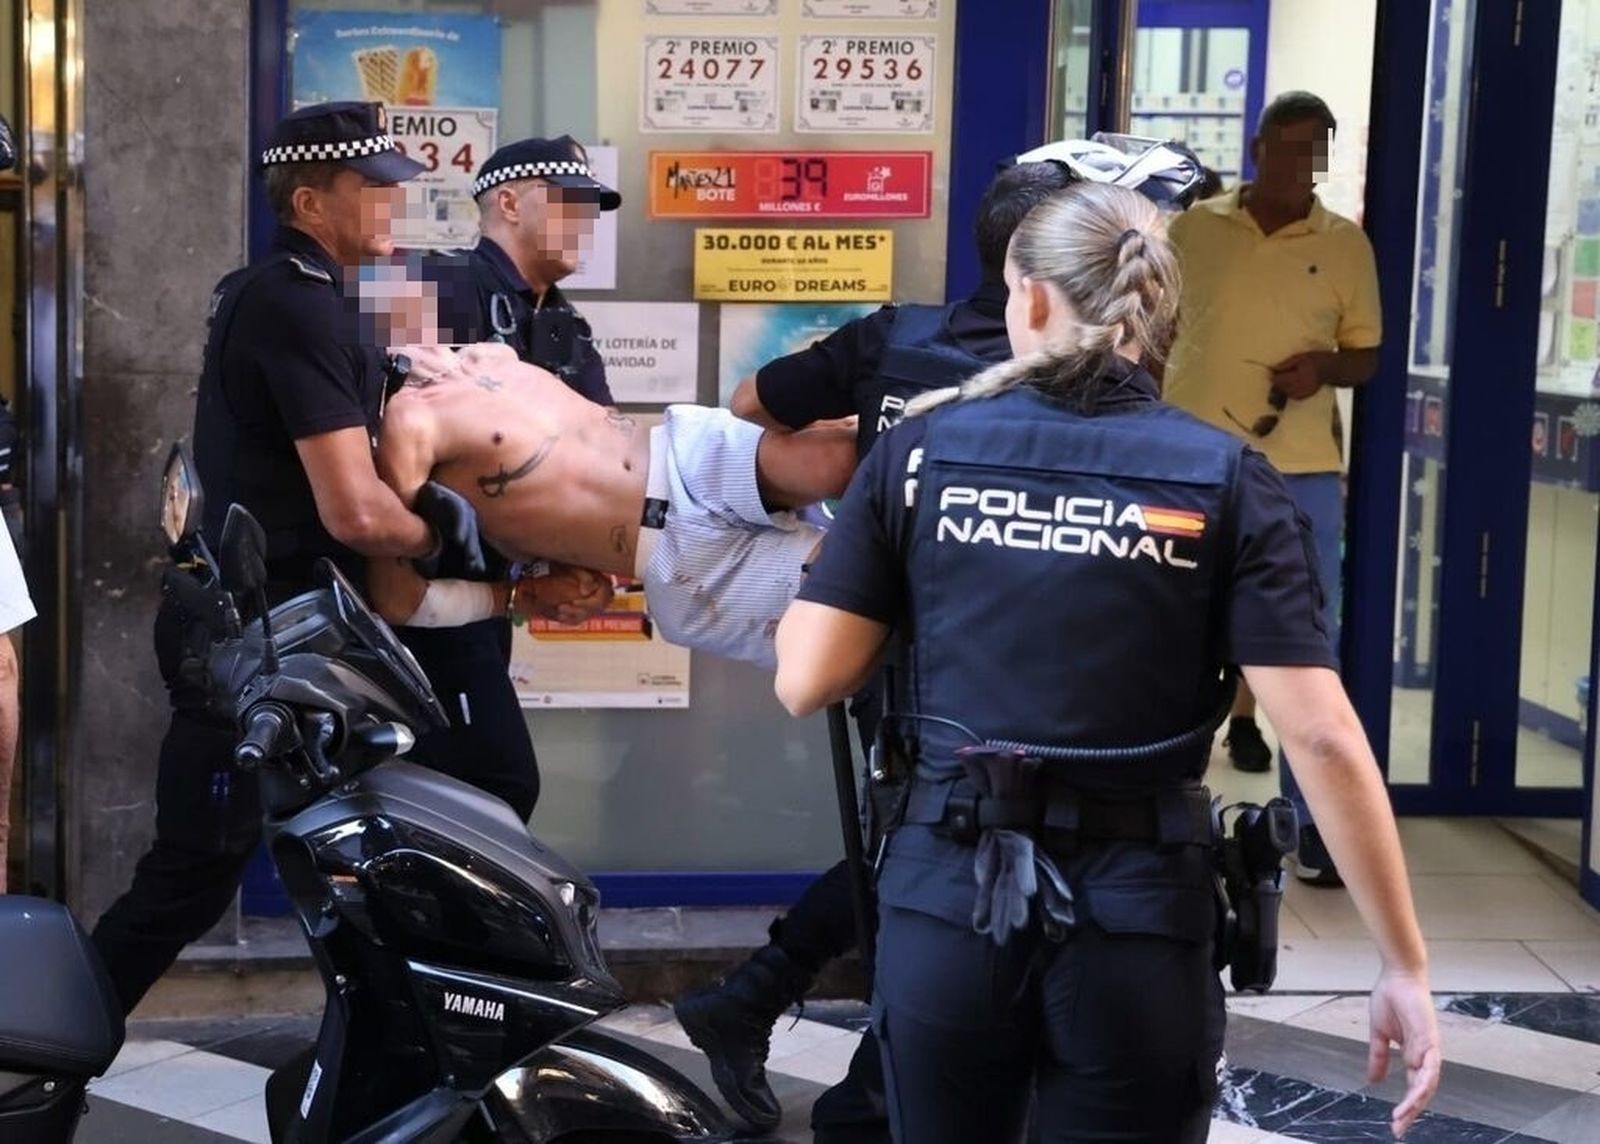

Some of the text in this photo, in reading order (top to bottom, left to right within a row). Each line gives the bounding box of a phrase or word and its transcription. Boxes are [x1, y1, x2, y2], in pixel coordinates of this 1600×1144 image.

[690, 41, 757, 56] PREMIO
[846, 40, 914, 55] PREMIO
[658, 58, 765, 79] 24077
[813, 58, 923, 80] 29536
[393, 116, 457, 137] EMIO
[782, 158, 827, 201] 39
[697, 188, 736, 201] BOTE
[758, 202, 812, 212] MILLONES
[703, 235, 781, 251] 30.000
[786, 235, 798, 250] €
[803, 235, 830, 250] AL
[728, 279, 777, 292] EURO
[795, 279, 867, 293] DREAMS
[605, 336, 658, 350] LOTERÍA
[661, 339, 677, 350] DE
[937, 516, 1198, 569] NACIONAL
[444, 992, 505, 1021] YAMAHA
